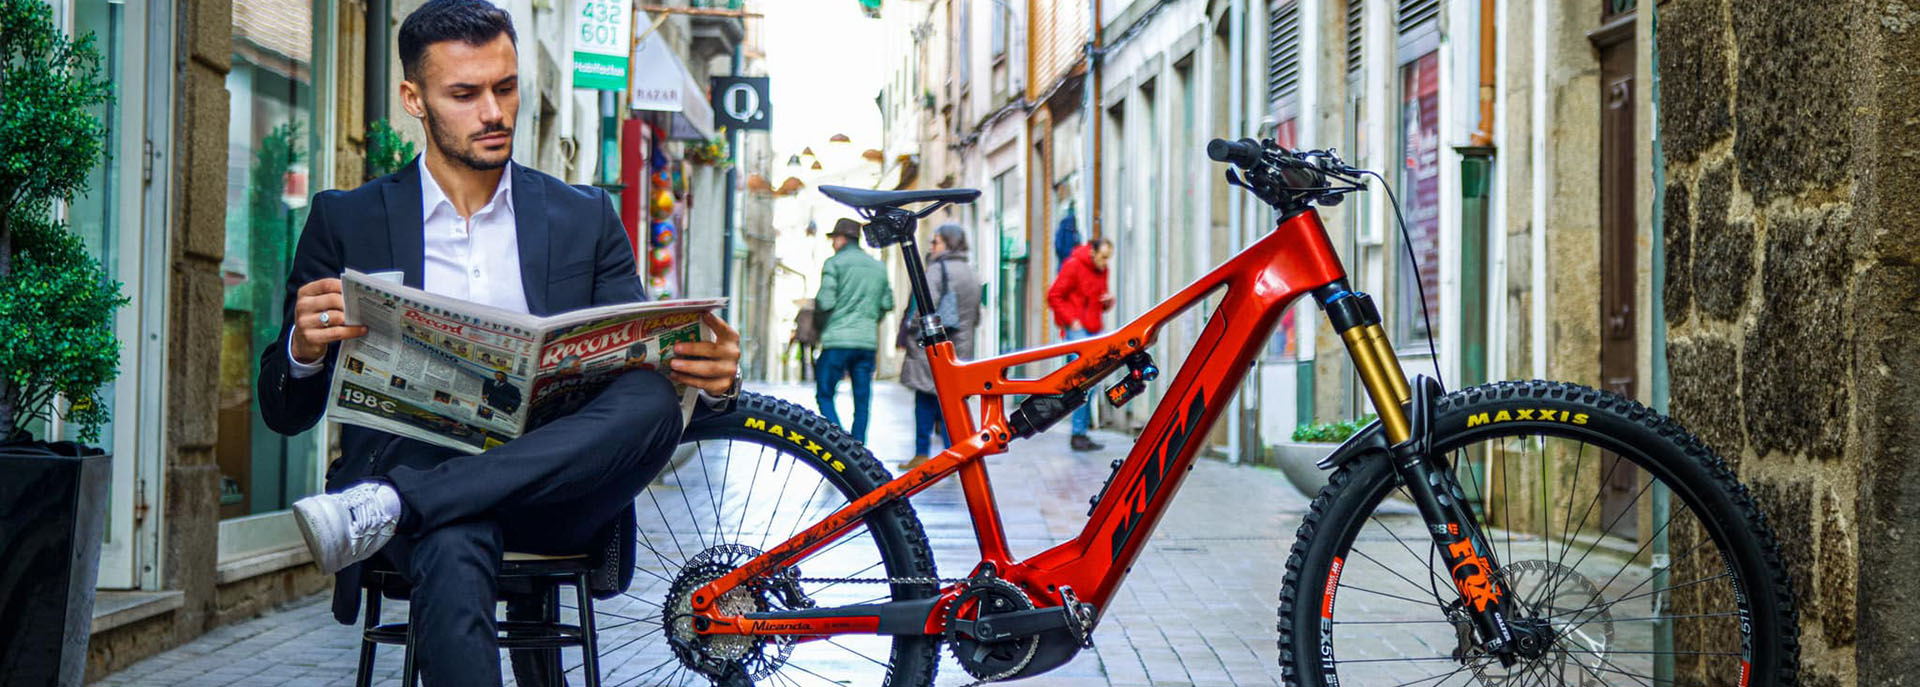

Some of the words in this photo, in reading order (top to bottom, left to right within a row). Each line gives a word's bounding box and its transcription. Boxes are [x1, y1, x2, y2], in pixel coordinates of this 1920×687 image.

[582, 2, 621, 24] 432
[581, 23, 616, 45] 601
[637, 88, 678, 100] BAZAR
[404, 309, 463, 336] Record
[542, 323, 632, 367] Record
[344, 388, 397, 413] 198€
[1467, 409, 1590, 428] MAXXIS
[744, 417, 846, 473] MAXXIS
[1448, 537, 1499, 613] FOX
[751, 621, 812, 633] Miranda
